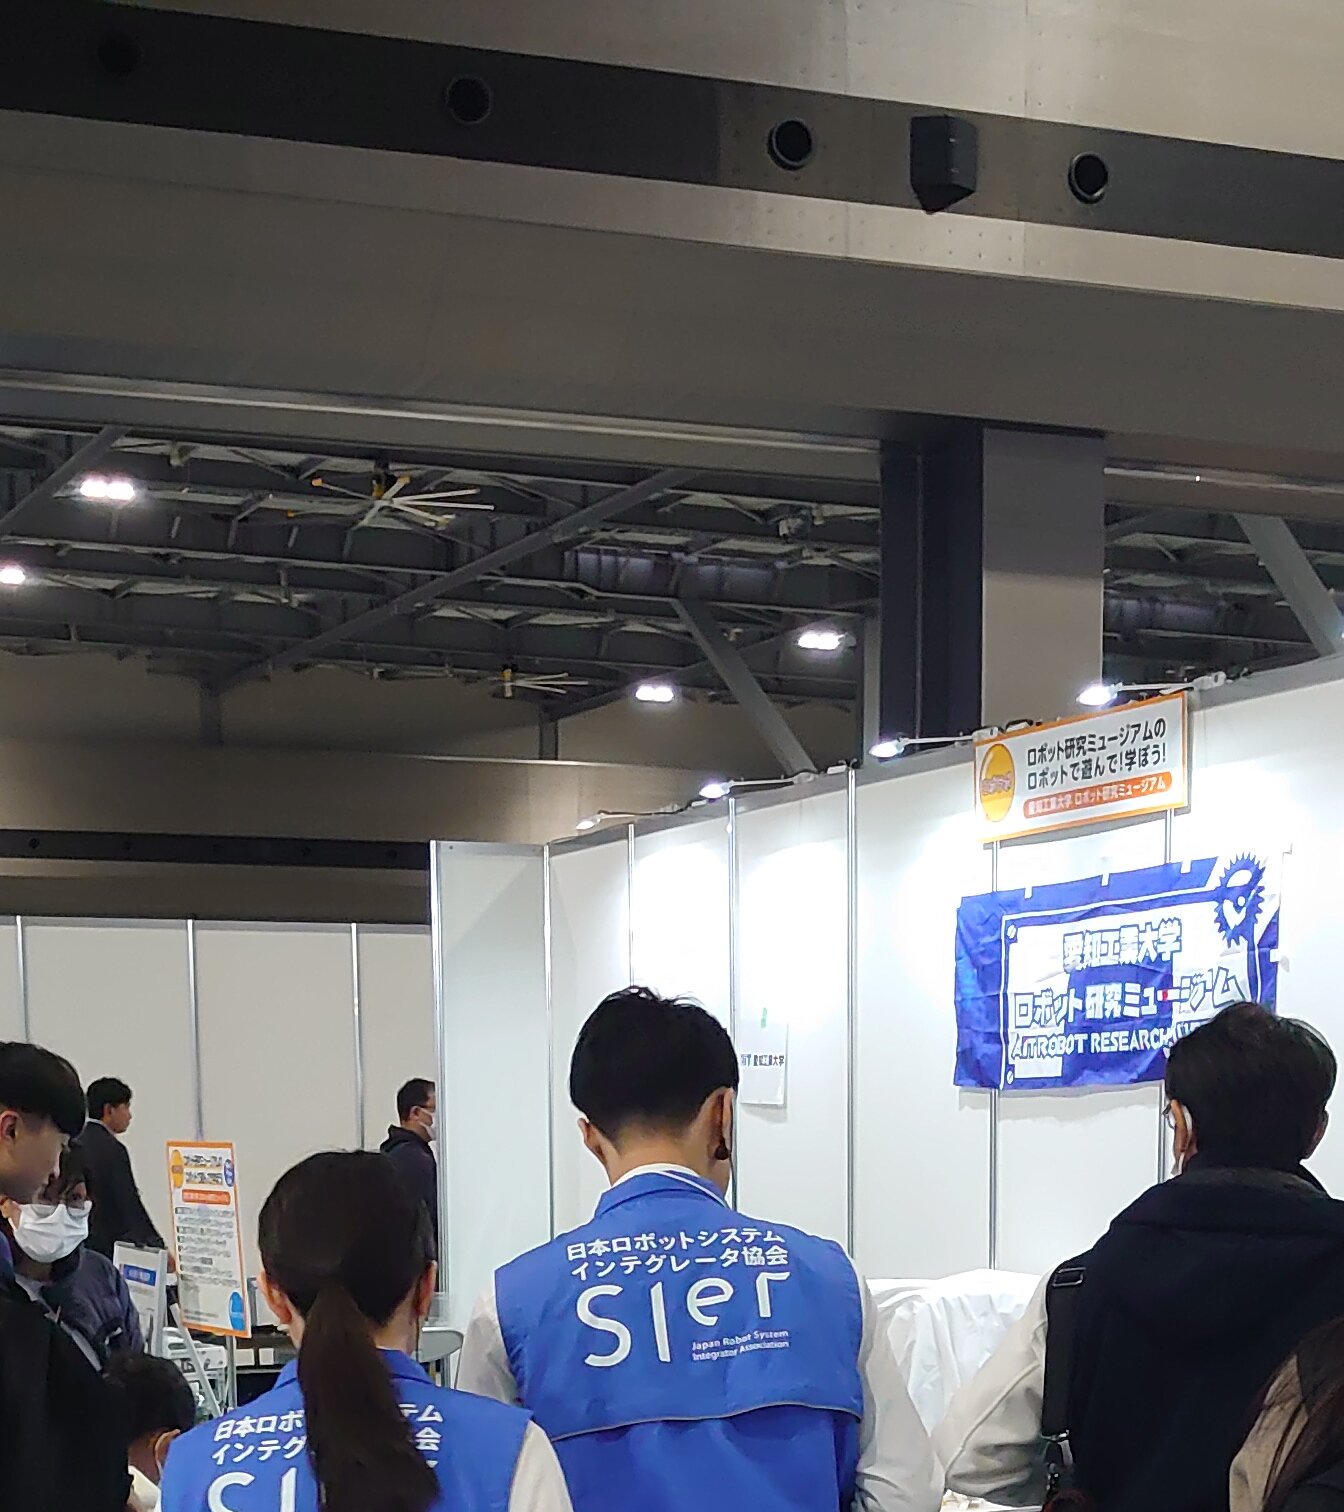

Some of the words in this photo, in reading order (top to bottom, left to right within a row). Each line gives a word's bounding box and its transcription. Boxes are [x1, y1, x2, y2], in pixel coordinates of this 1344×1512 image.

[1028, 718, 1166, 766] ロボット研究ミュージアムの
[1028, 743, 1166, 790] ロボットで遊んで!学ぼう!
[1074, 777, 1166, 806] ロボット研究ミュージアム
[1063, 917, 1182, 974] 愛知工業大学
[1091, 1027, 1171, 1054] RESEARCH
[567, 1228, 785, 1261] 日本ロボットシステム
[571, 1244, 789, 1281] インテグレータ協会
[692, 1339, 721, 1352] Japan
[723, 1333, 751, 1347] Robot
[753, 1330, 789, 1342] System
[692, 1348, 737, 1361] Integrator
[739, 1341, 789, 1354] Association
[214, 1404, 443, 1442] 日本ロボテム
[212, 1427, 442, 1466] インテグ会
